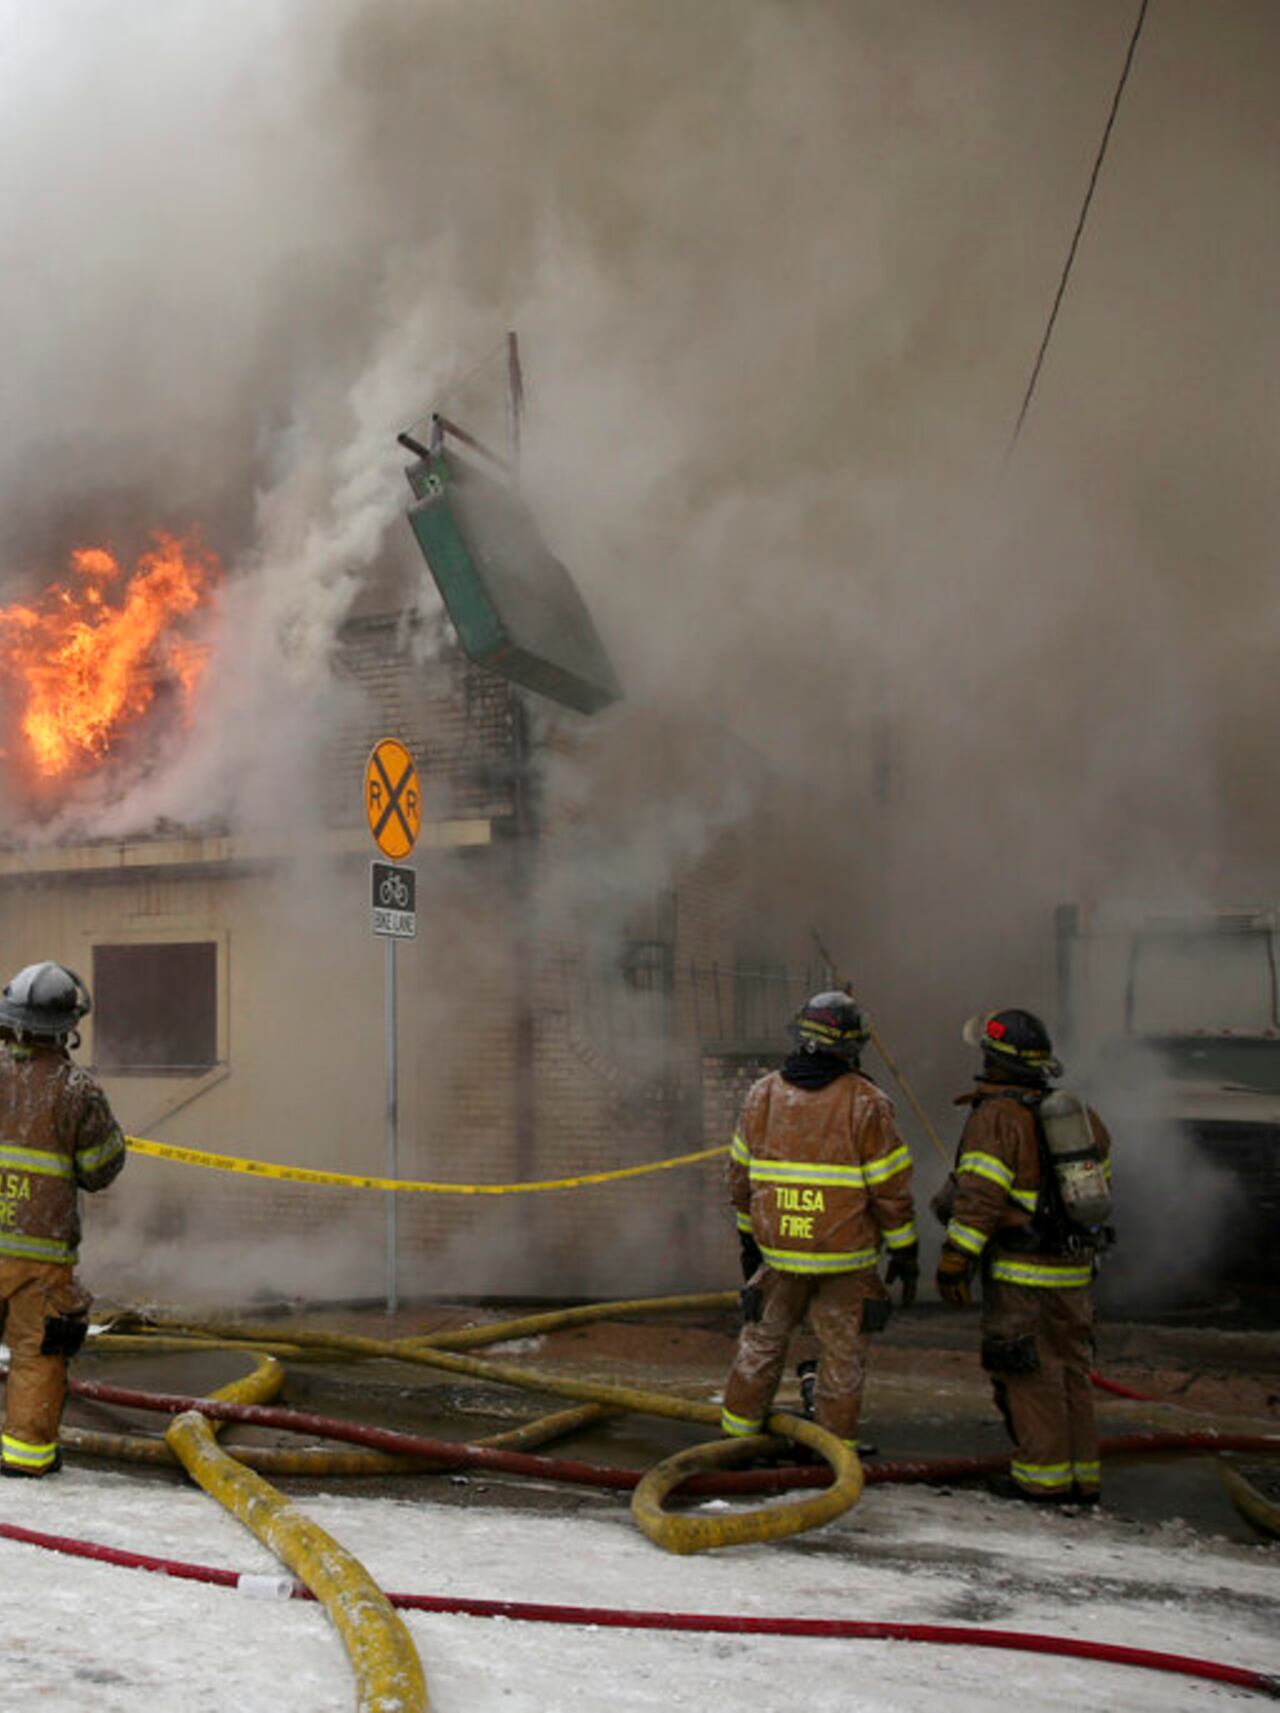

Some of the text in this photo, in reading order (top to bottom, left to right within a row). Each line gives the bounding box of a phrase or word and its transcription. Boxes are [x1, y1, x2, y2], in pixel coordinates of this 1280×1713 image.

[393, 914, 414, 933] LANE
[775, 1187, 825, 1213] TULSA
[780, 1214, 815, 1239] FIRE
